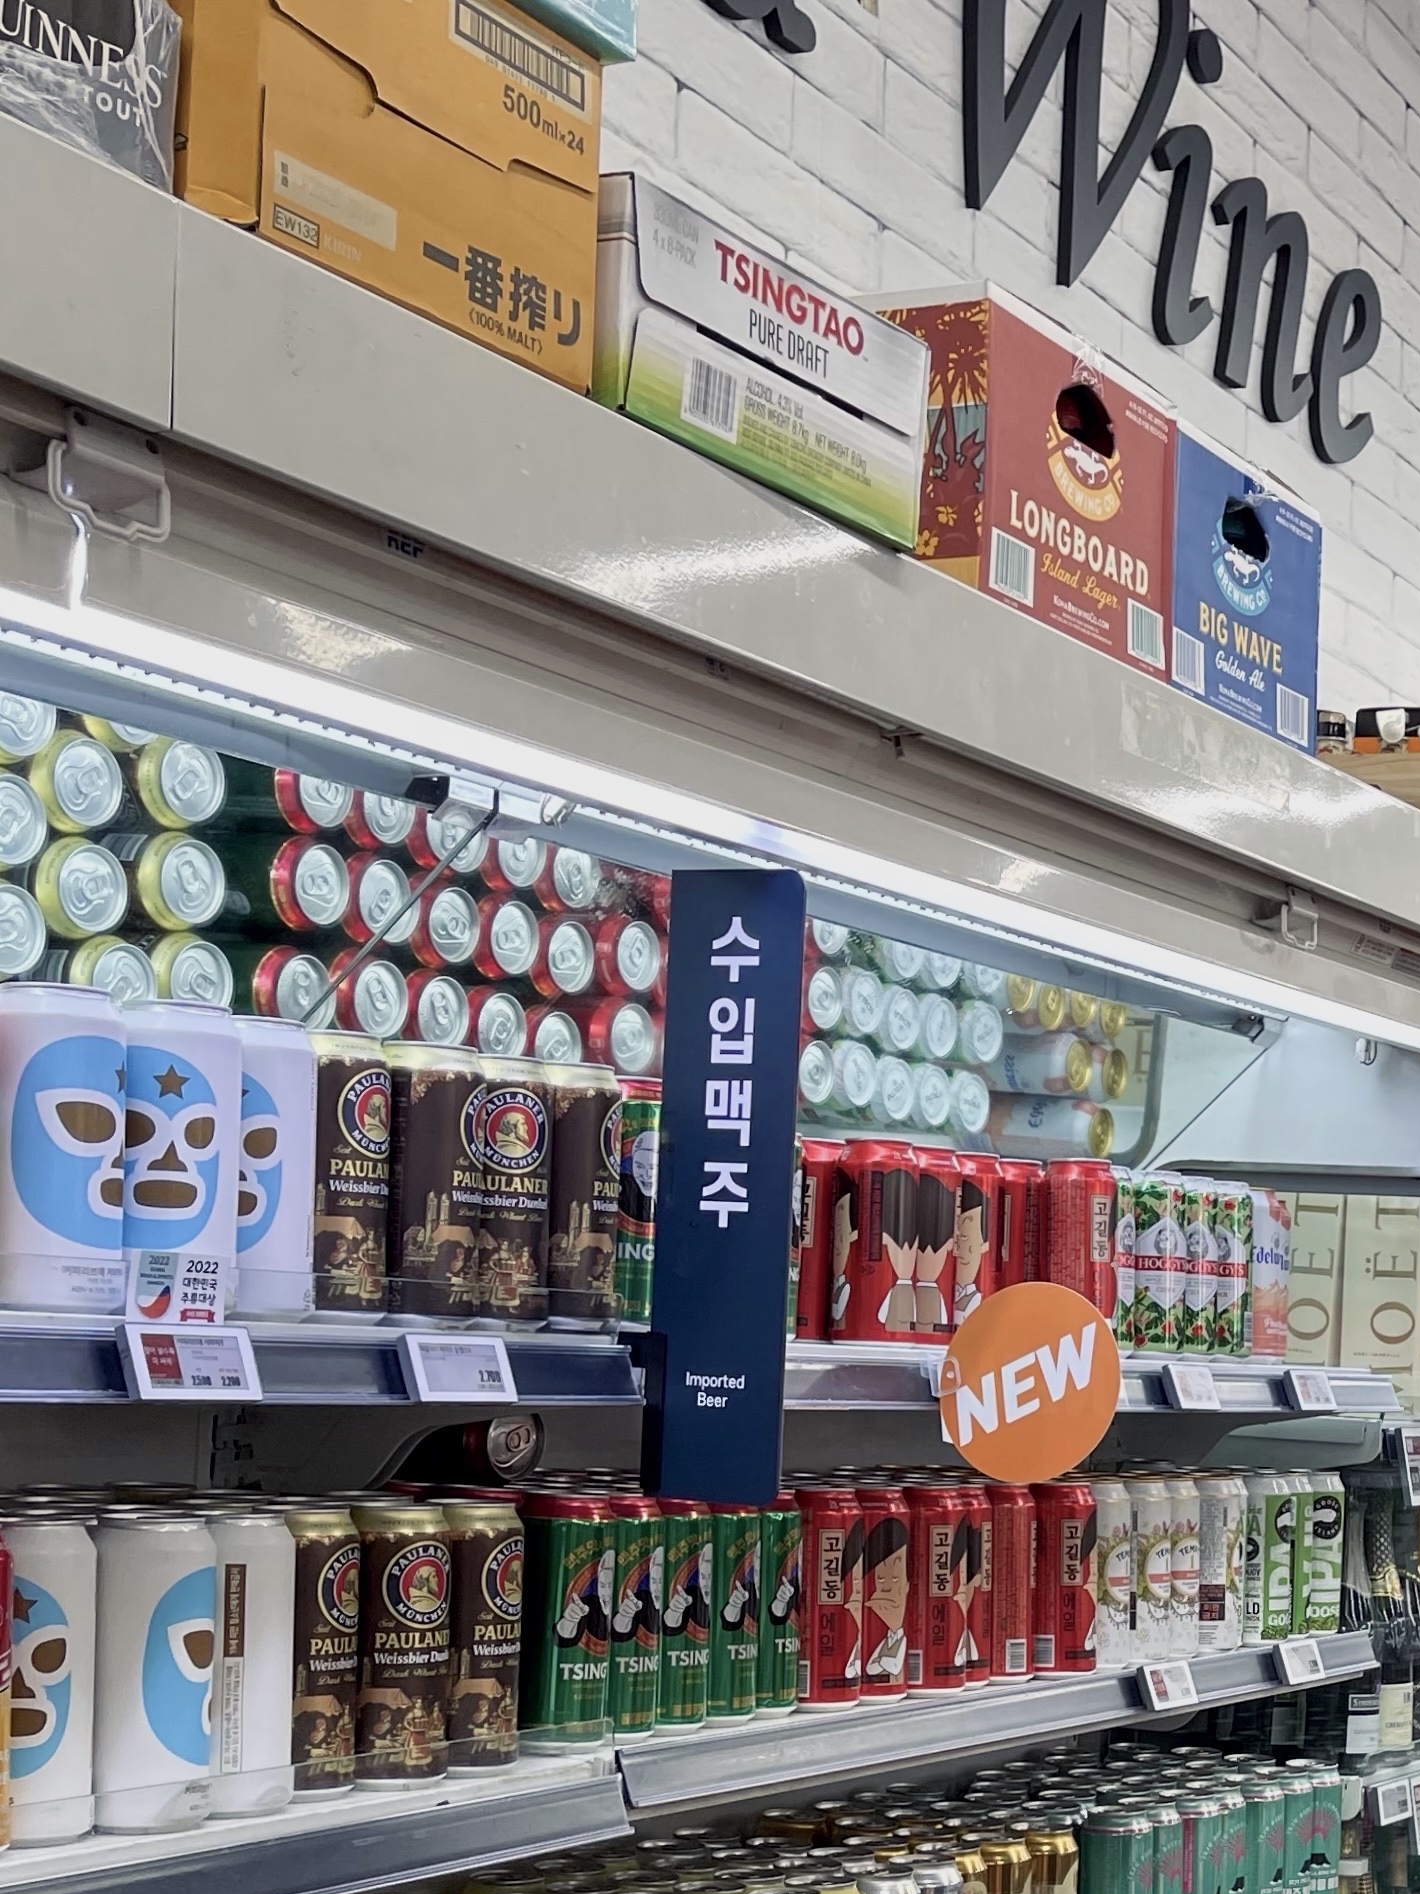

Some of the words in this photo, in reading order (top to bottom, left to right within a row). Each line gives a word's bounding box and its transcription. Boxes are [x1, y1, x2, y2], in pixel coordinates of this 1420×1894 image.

[274, 208, 319, 243] EW132
[962, 0, 1381, 464] Wine
[422, 240, 583, 346] 一番搾り
[714, 238, 864, 357] TSINGTAO
[749, 308, 784, 356] PURE
[786, 330, 830, 380] DRAFT
[1053, 459, 1102, 514] BREWING
[1009, 488, 1150, 598] LONGBOARD
[1040, 553, 1080, 590] Island
[1081, 575, 1119, 610] Lager
[1216, 564, 1257, 611] BREWING
[1199, 600, 1229, 648] BIG
[1233, 620, 1284, 678] WAVE
[1215, 650, 1246, 686] Golden
[1249, 668, 1266, 692] Ale
[699, 915, 761, 1229] 수입맥주
[1092, 1201, 1110, 1261] 고길동
[182, 1277, 218, 1291] 대한민국
[186, 1260, 219, 1275] 2022
[685, 1371, 746, 1392] Imported
[696, 1391, 728, 1409] Beer
[956, 1321, 1097, 1447] NEW
[821, 1535, 842, 1600] 고길동
[932, 1530, 951, 1592] 고길동
[1063, 1523, 1081, 1581] 고길동
